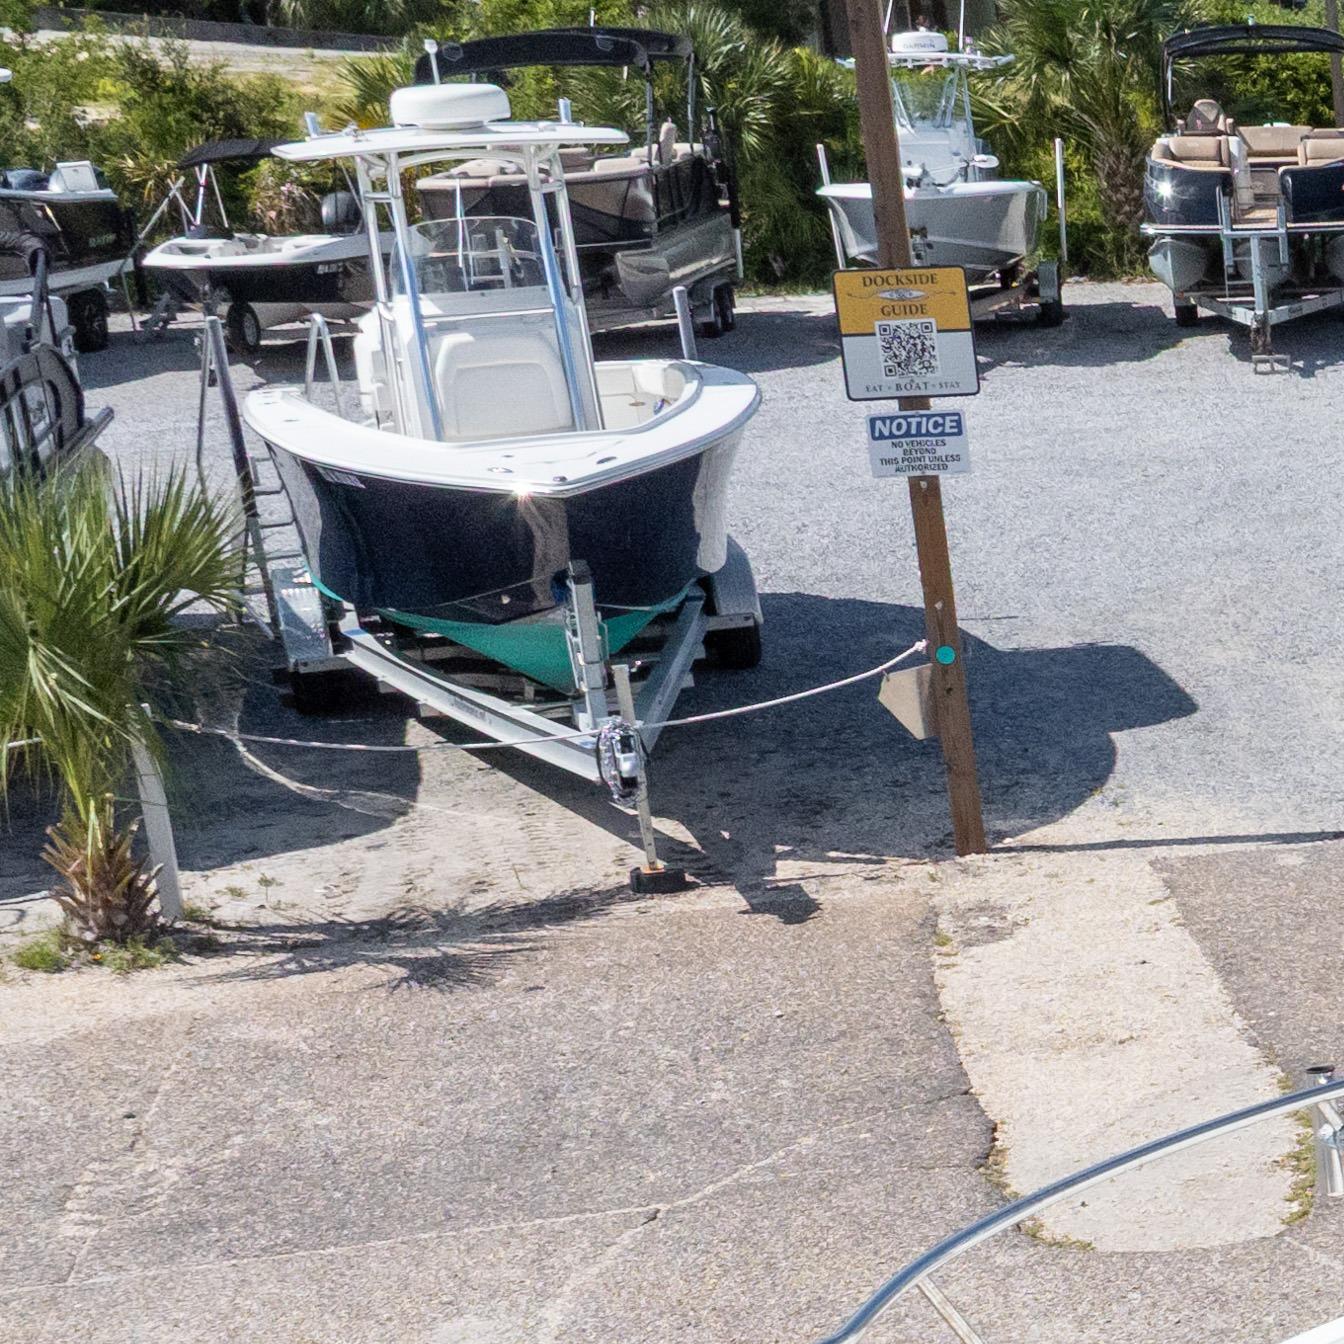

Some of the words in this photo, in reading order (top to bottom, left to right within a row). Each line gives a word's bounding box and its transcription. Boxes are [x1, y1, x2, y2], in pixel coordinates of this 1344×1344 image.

[861, 273, 939, 288] DOCKSIDE
[880, 303, 928, 317] GUIDE
[865, 384, 883, 393] EAT
[895, 381, 930, 392] BOAT
[938, 380, 961, 389] STAY
[874, 415, 960, 438] NOTICE
[891, 440, 904, 449] NO
[906, 438, 947, 448] VEHICLES
[902, 447, 937, 456] BEYOND
[880, 457, 900, 466] THIS
[901, 456, 926, 464] POINT
[928, 454, 961, 463] UNLESS
[895, 463, 949, 473] AUTHORIZED
